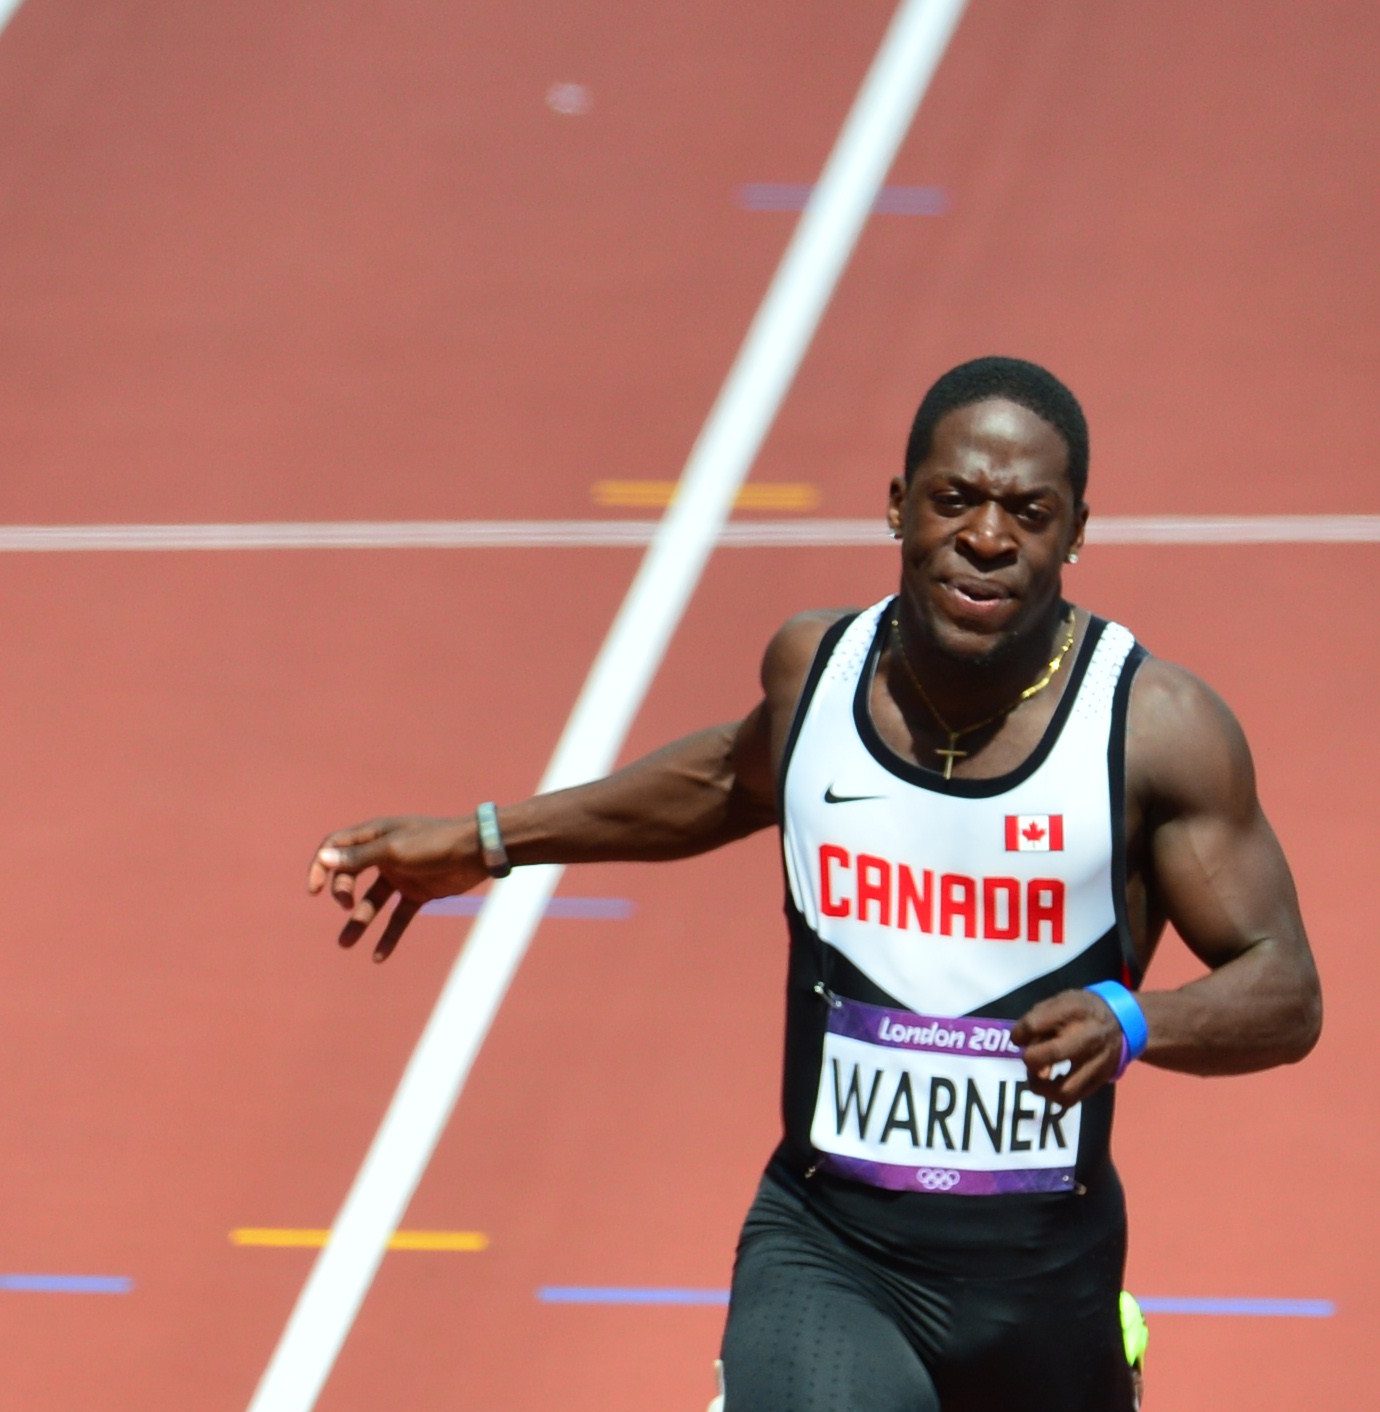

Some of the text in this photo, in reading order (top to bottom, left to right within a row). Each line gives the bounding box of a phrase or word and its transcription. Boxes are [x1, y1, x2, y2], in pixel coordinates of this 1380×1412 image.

[818, 842, 1065, 945] CANADA
[877, 1016, 967, 1050] London
[831, 1057, 1068, 1155] WARNER
